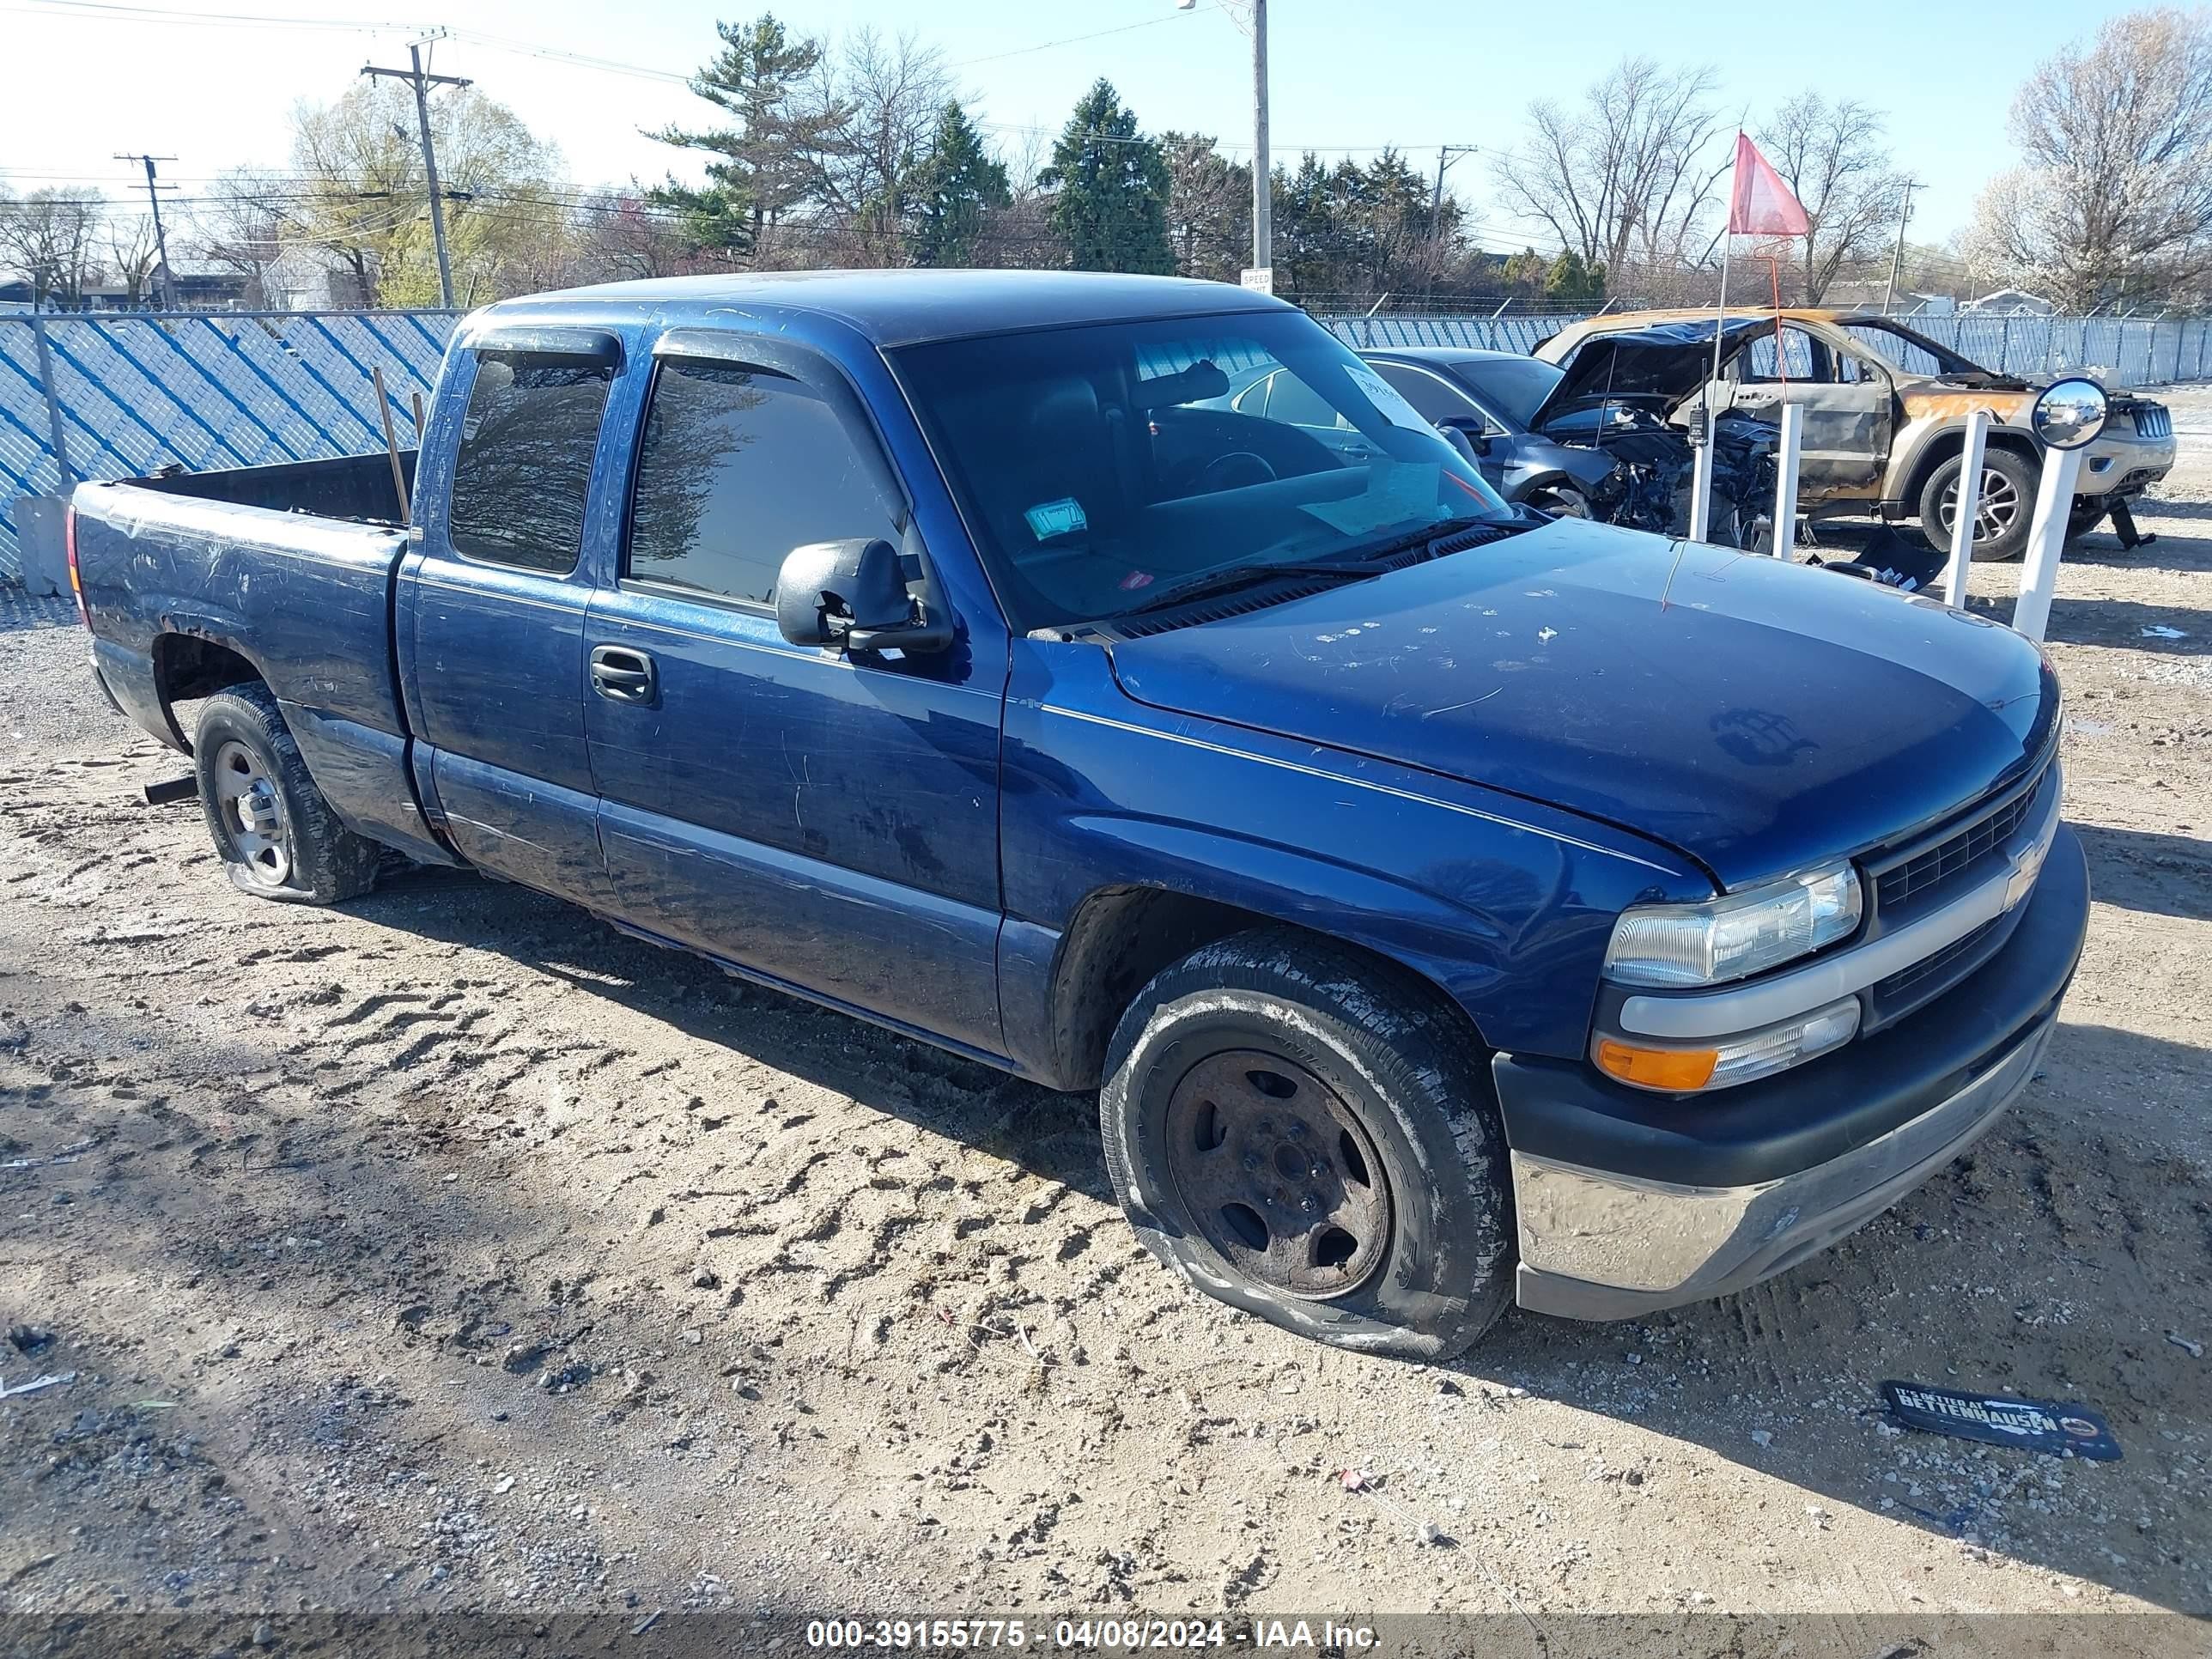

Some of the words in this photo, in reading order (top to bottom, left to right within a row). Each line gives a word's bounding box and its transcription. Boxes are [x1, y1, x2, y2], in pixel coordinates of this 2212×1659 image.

[1244, 275, 1269, 284] SPEED
[1894, 1387, 1918, 1399] IT'S
[1921, 1392, 1966, 1407] BETTER
[1969, 1401, 1984, 1410] AT
[1898, 1395, 2058, 1431] BETTENHAUSEN
